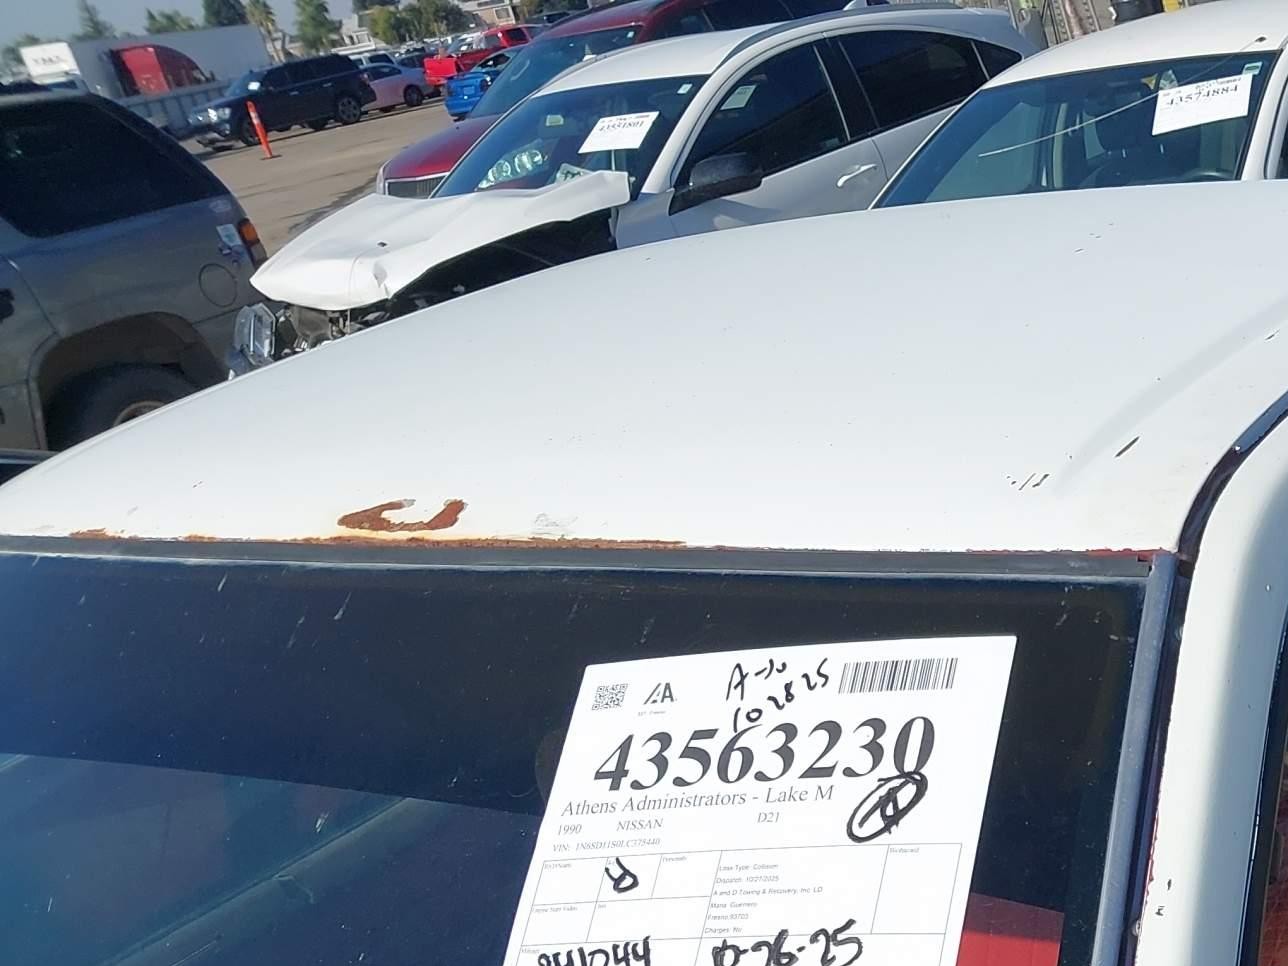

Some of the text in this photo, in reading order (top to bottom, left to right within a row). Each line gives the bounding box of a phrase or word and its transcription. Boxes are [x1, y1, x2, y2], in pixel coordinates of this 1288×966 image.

[594, 716, 935, 791] 43563230
[560, 799, 618, 818] Athens
[621, 789, 747, 812] Administrators
[765, 785, 808, 804] Lake
[814, 784, 835, 801] M
[557, 817, 664, 836] 1990 NISSAN
[756, 811, 781, 824] D21
